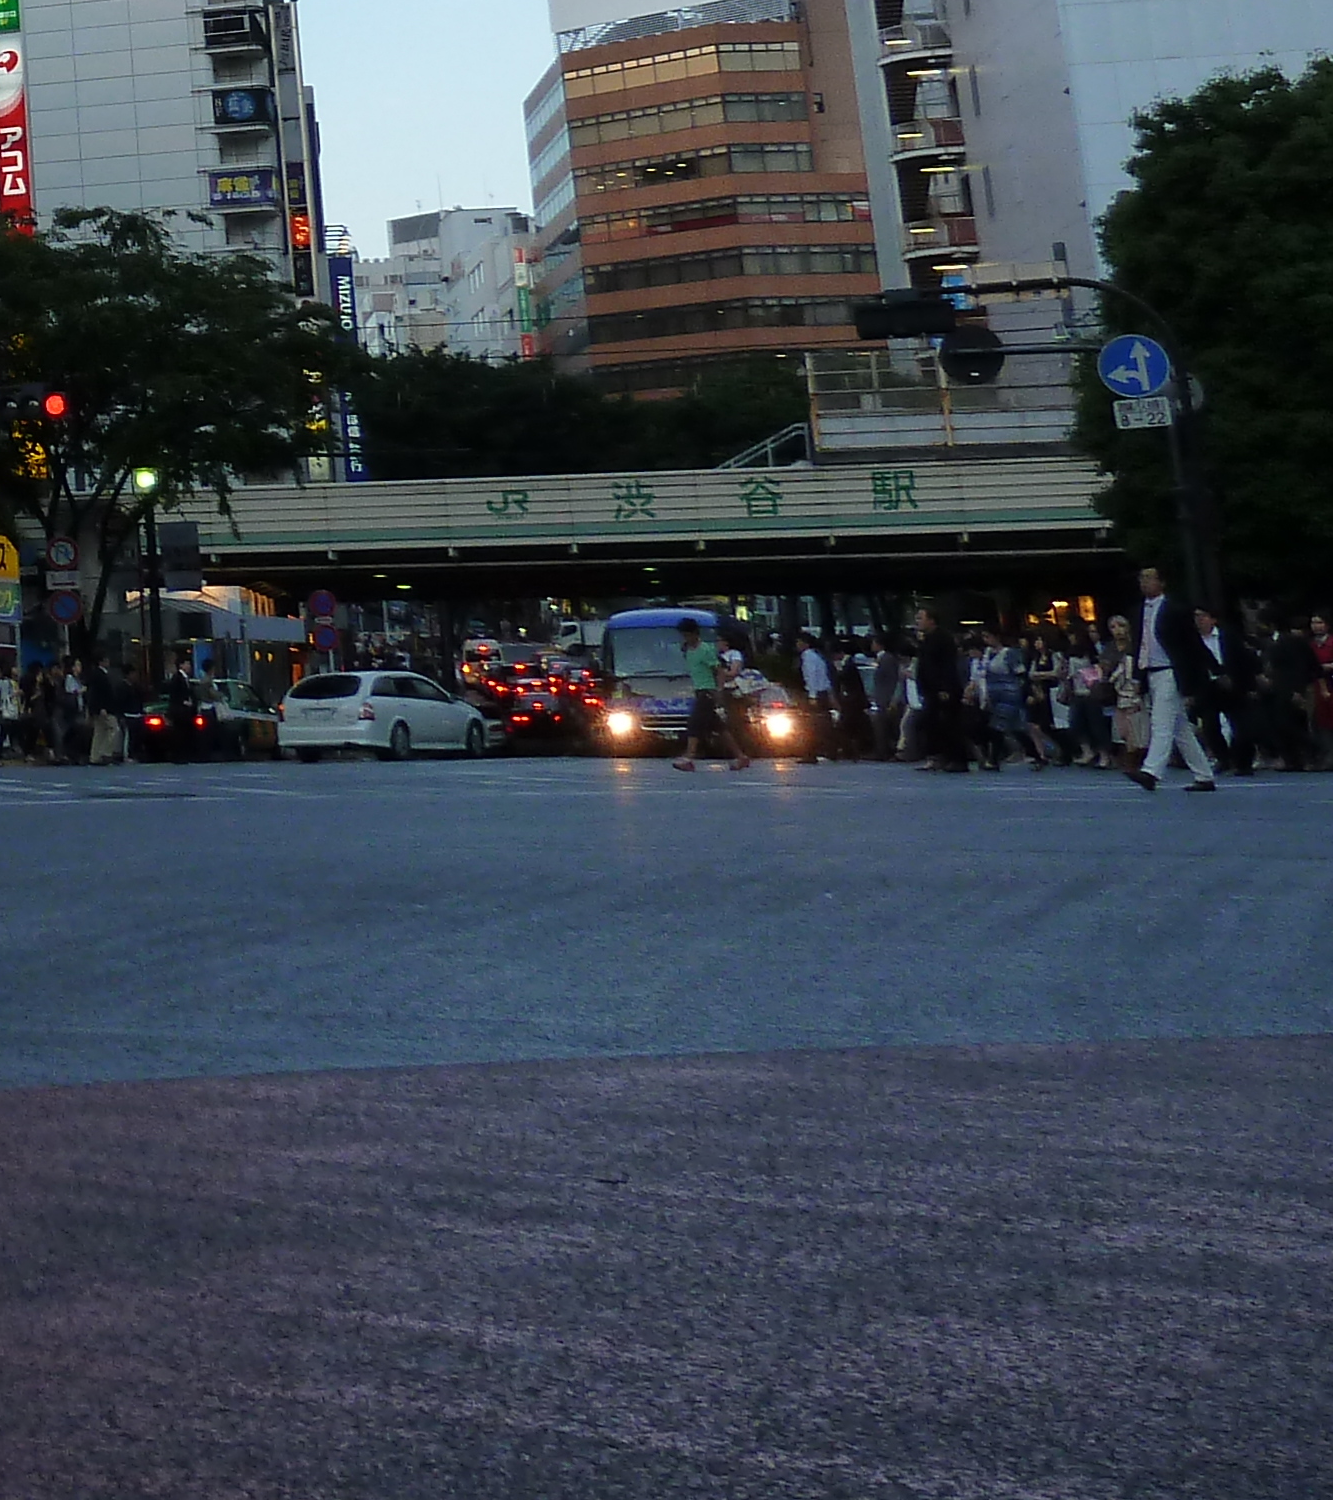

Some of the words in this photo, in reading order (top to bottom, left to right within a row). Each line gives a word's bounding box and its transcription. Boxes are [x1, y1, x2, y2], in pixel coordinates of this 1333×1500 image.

[486, 489, 531, 515] JR
[611, 469, 920, 521] 渋谷駅
